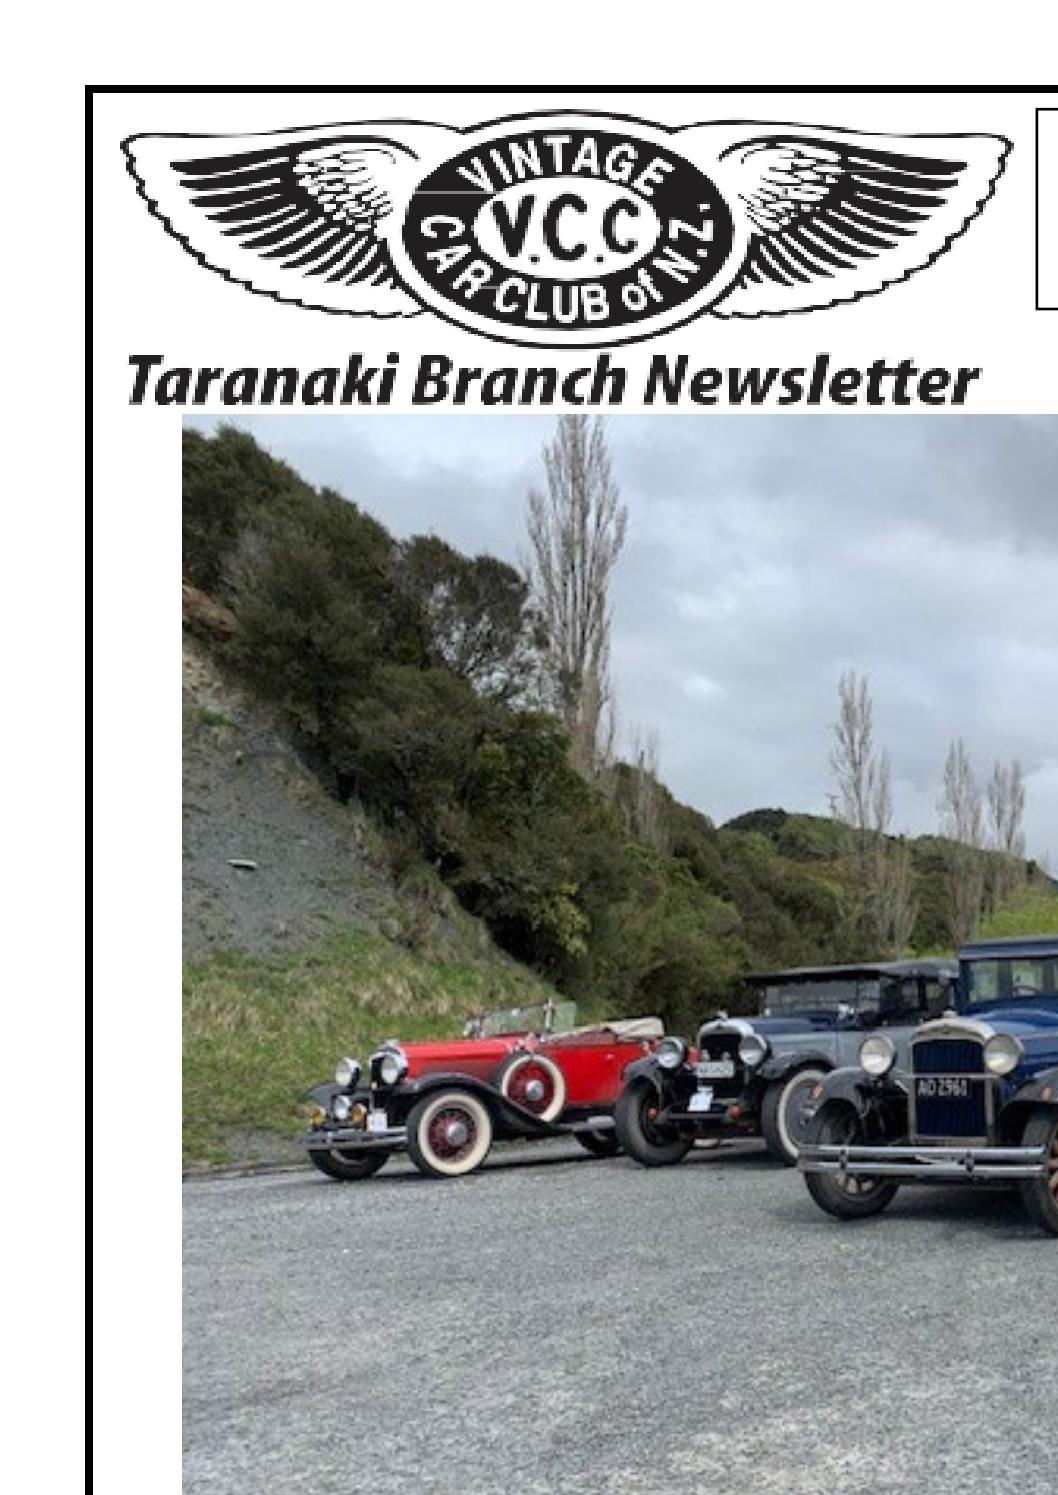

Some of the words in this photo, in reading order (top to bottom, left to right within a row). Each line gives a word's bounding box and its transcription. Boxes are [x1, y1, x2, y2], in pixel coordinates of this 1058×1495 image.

[456, 134, 676, 196] VINTAGE
[420, 214, 494, 299] CAR
[494, 276, 610, 322] CLUB
[622, 266, 664, 311] of
[127, 352, 399, 406] Taranaki
[412, 353, 625, 406] Branch
[643, 353, 982, 406] Newsletter
